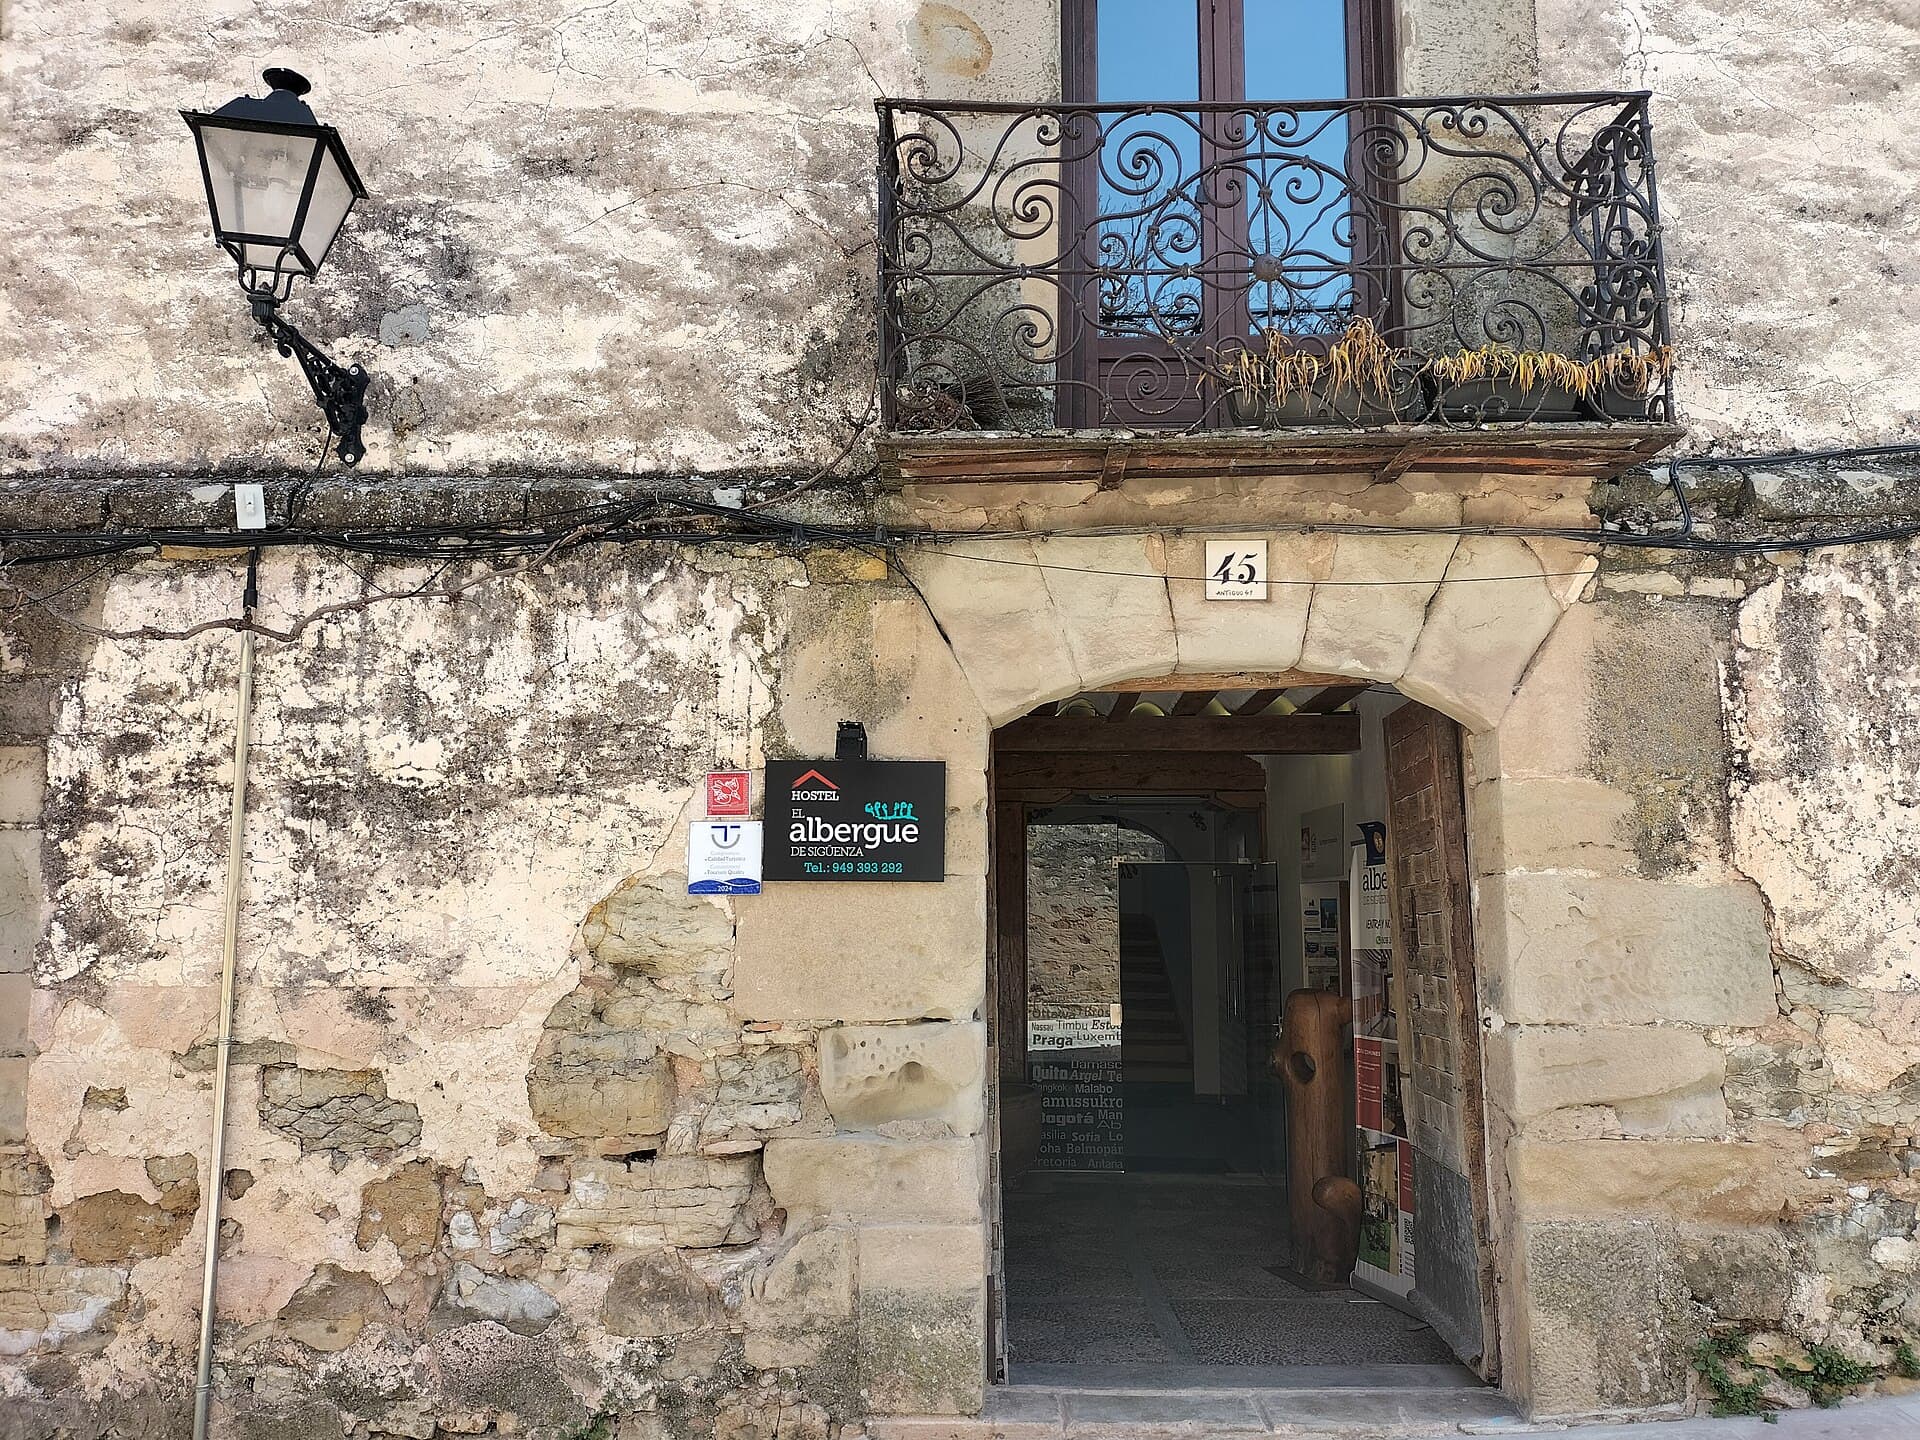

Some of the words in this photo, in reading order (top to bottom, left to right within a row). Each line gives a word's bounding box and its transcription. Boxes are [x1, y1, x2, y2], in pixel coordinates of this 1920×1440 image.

[791, 790, 839, 801] HOSTEL
[791, 808, 805, 818] EL
[789, 816, 919, 849] albergue
[790, 846, 807, 857] DE
[807, 844, 864, 857] SIGÜENZA
[803, 862, 830, 873] Tel.:
[832, 862, 854, 873] 949
[856, 862, 878, 873] 393
[881, 862, 903, 873] 292
[1032, 1034, 1073, 1048] Praga
[1032, 1065, 1067, 1082] Quito
[1070, 1069, 1102, 1083] Argel
[1075, 1083, 1113, 1093] Malabo
